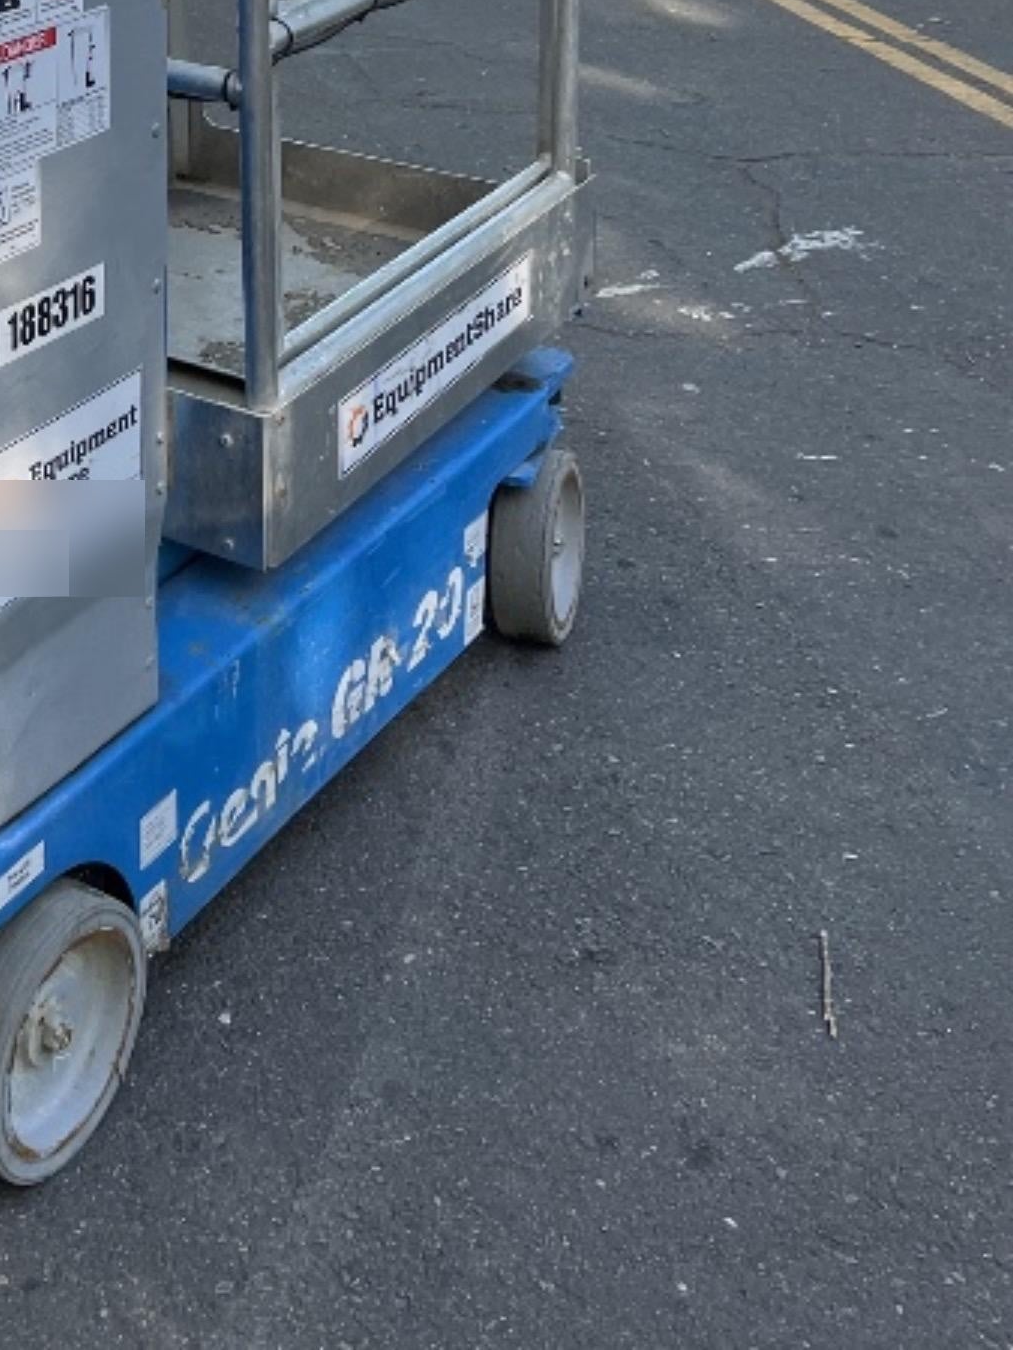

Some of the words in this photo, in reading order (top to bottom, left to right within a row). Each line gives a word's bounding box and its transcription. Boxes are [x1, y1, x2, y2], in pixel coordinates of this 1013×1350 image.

[7, 275, 97, 351] 188316
[373, 287, 523, 420] EquipmentShare
[29, 404, 138, 480] Equipment
